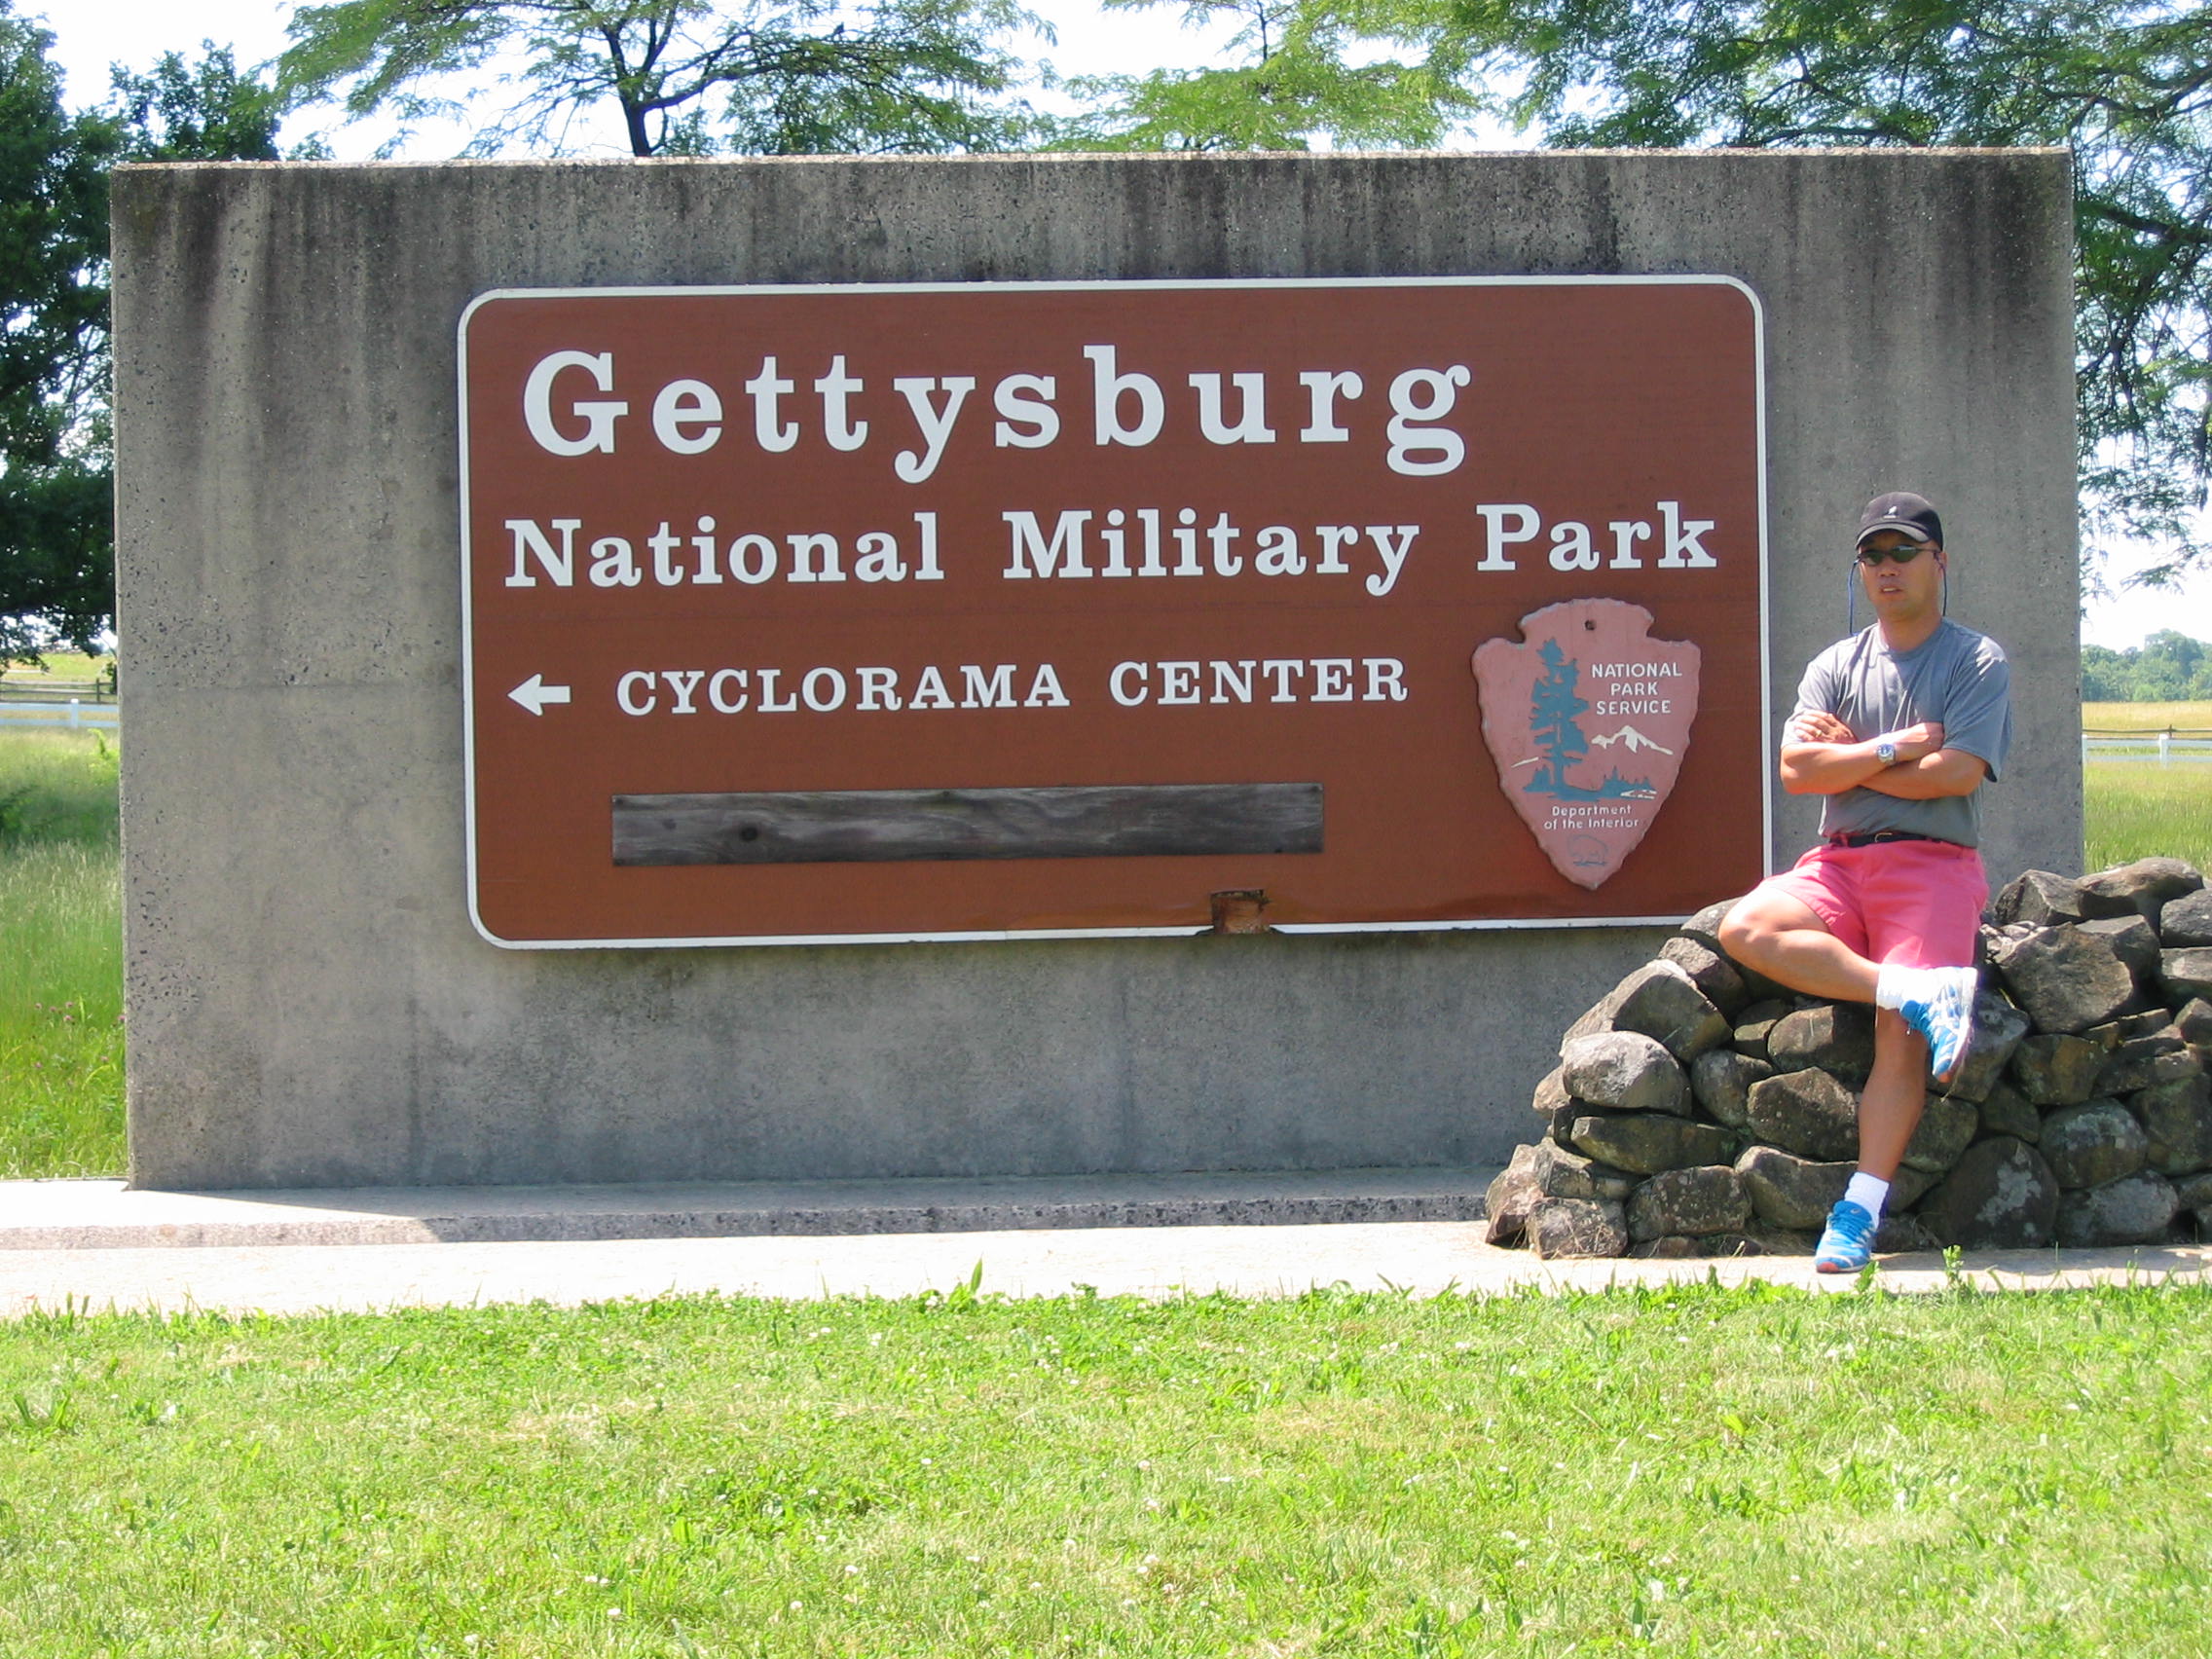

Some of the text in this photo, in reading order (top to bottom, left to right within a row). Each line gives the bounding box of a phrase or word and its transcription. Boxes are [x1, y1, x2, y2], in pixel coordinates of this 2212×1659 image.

[524, 346, 1470, 483] Gettysburg
[505, 501, 1716, 596] National Military Park
[1591, 662, 1682, 678] NATIONAL
[617, 658, 1407, 716] CYCLORAMA CENTER
[1610, 682, 1658, 696] PARK
[1596, 700, 1672, 715] SERVICE
[1551, 805, 1632, 819] Department
[1543, 817, 1640, 830] of the Interior
